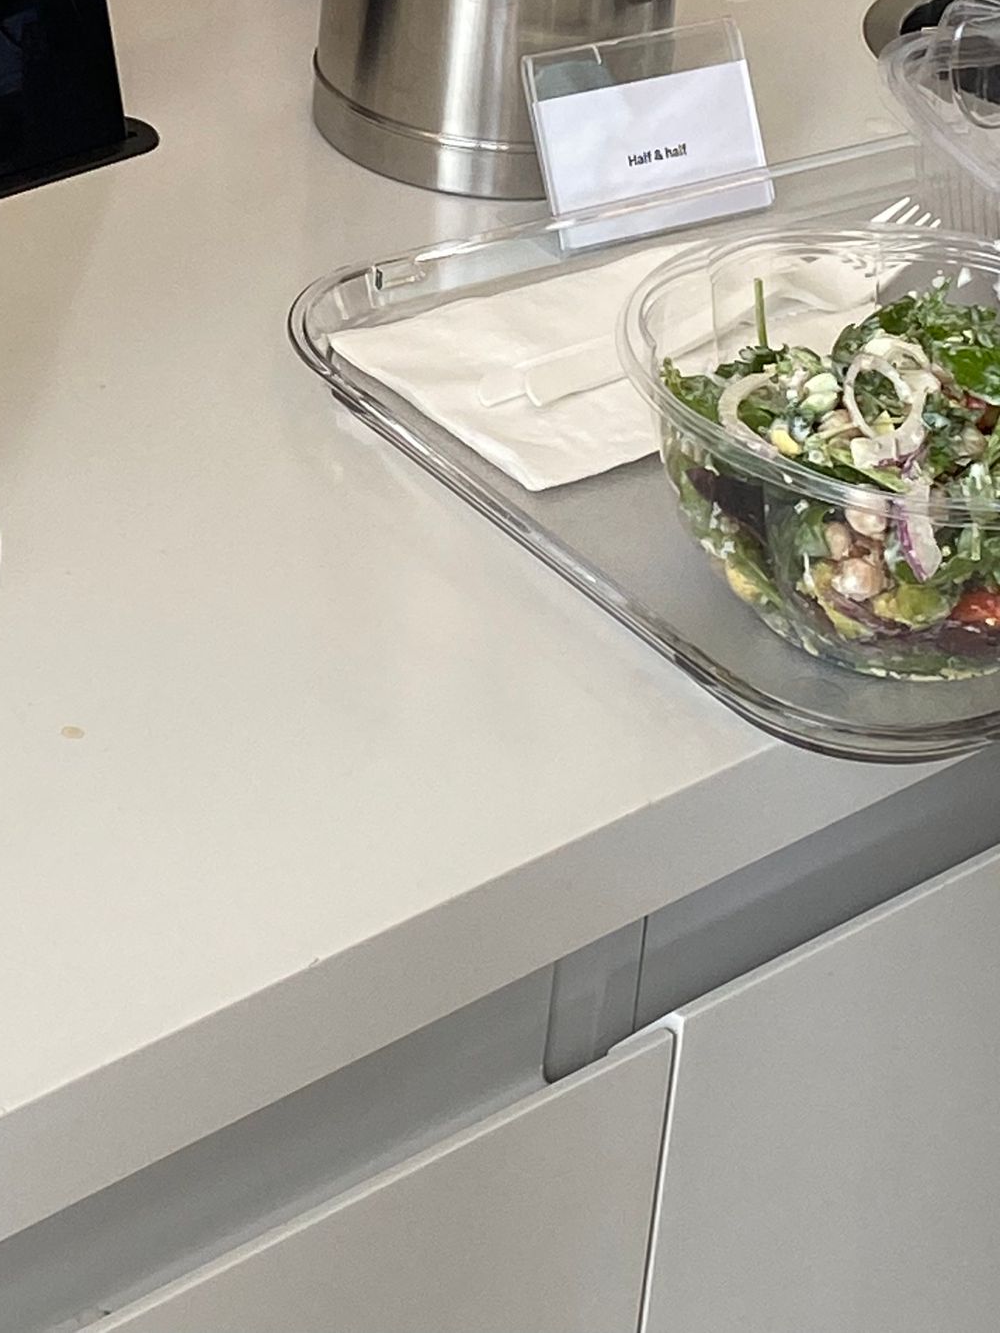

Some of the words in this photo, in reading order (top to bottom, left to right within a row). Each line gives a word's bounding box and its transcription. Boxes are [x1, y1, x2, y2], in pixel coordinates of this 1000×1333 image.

[627, 150, 652, 167] Half
[654, 149, 664, 161] &
[664, 142, 687, 159] half
